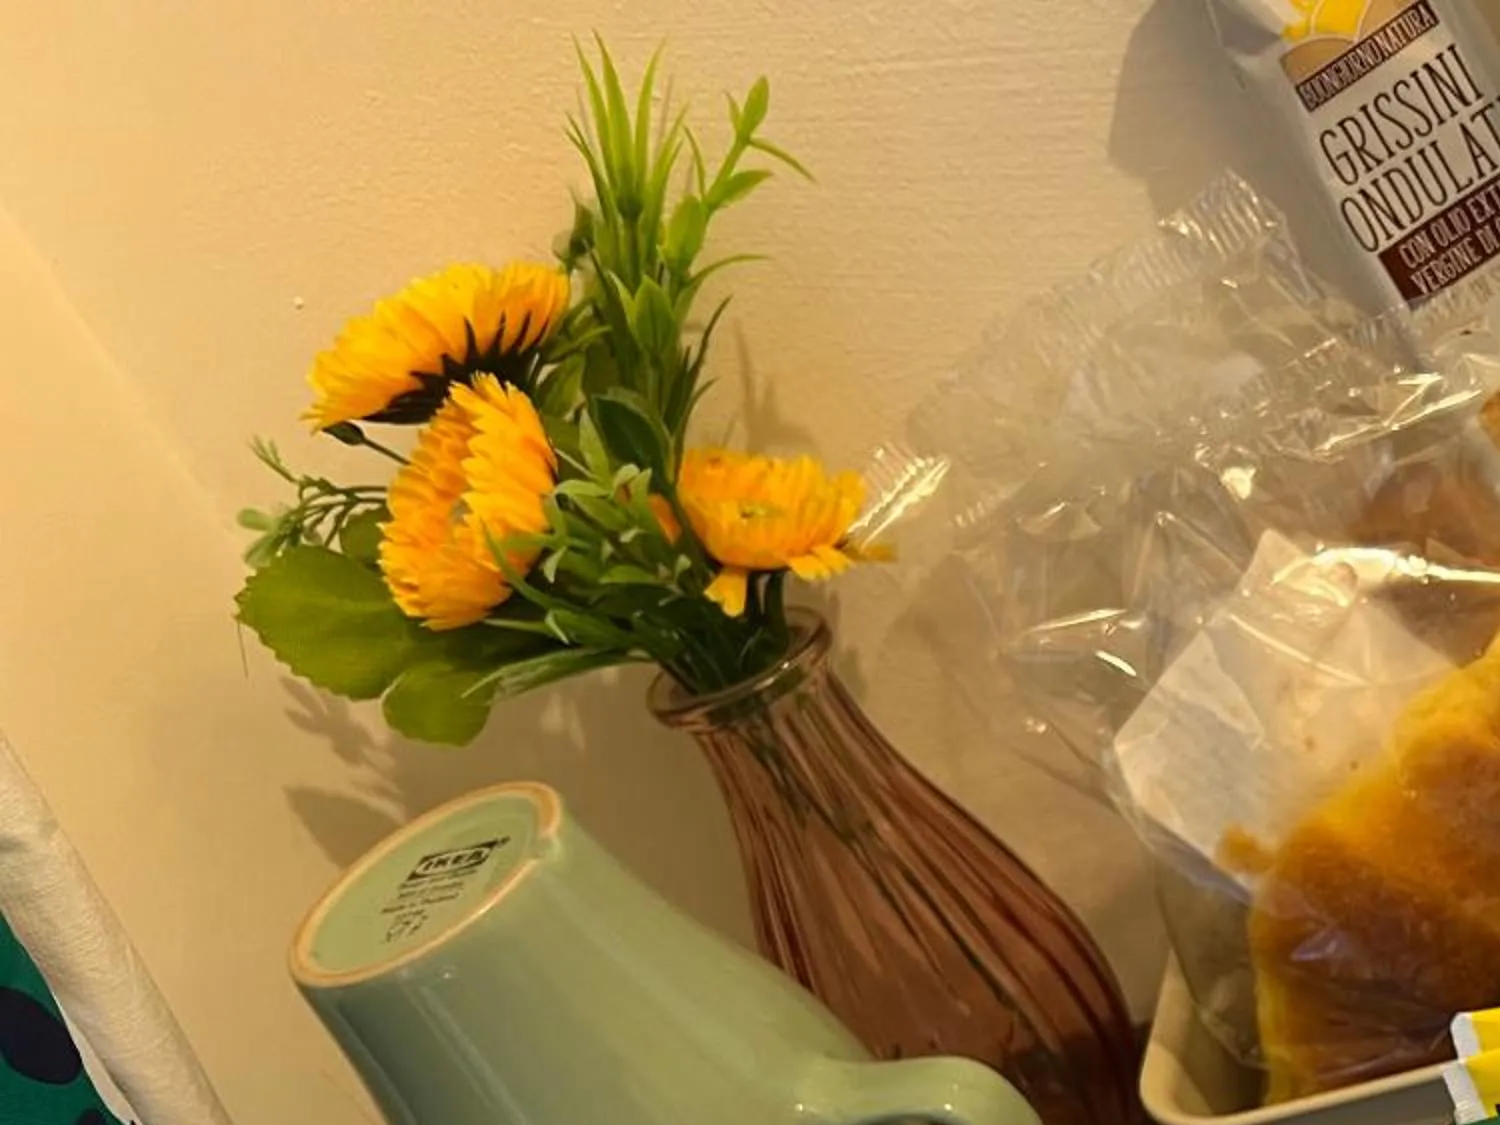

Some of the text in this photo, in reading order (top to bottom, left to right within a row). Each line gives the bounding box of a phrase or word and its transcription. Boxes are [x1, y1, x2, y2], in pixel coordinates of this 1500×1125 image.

[1320, 44, 1484, 185] GRISSINI
[1400, 229, 1436, 270] CON
[1430, 207, 1471, 247] OLIO
[1410, 237, 1482, 295] VERGINE
[1475, 225, 1500, 255] DI
[422, 850, 484, 872] IKEA
